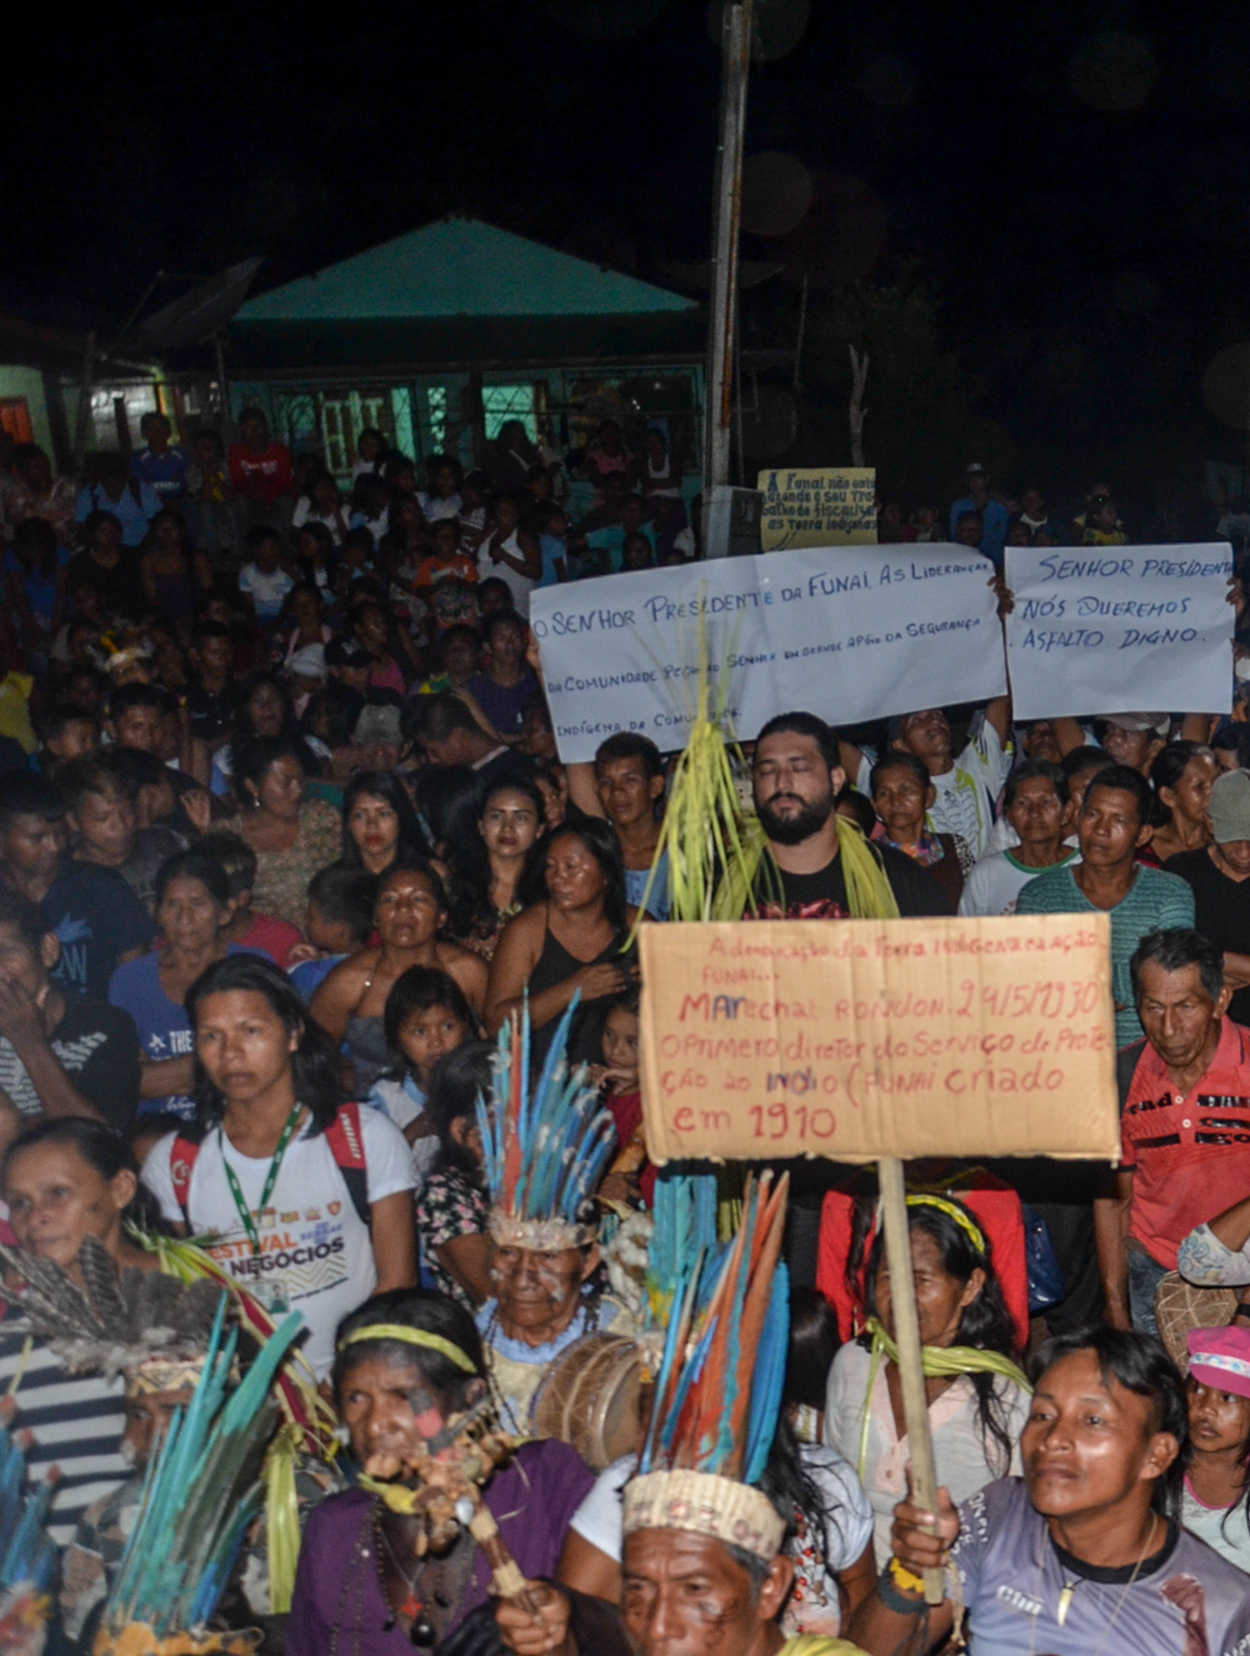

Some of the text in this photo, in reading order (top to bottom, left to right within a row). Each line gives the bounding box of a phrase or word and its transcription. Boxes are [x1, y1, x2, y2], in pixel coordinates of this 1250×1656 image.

[767, 472, 778, 491] A
[1039, 554, 1135, 582] SENHOR
[551, 609, 637, 636] SENHOR
[643, 592, 773, 623] PRESIDENTE
[781, 587, 802, 602] DA
[1022, 594, 1192, 620] NÓS QUEREMOS
[563, 668, 658, 692] COMUNIDADE
[873, 1032, 908, 1061] do
[673, 1101, 837, 1140] em 1910
